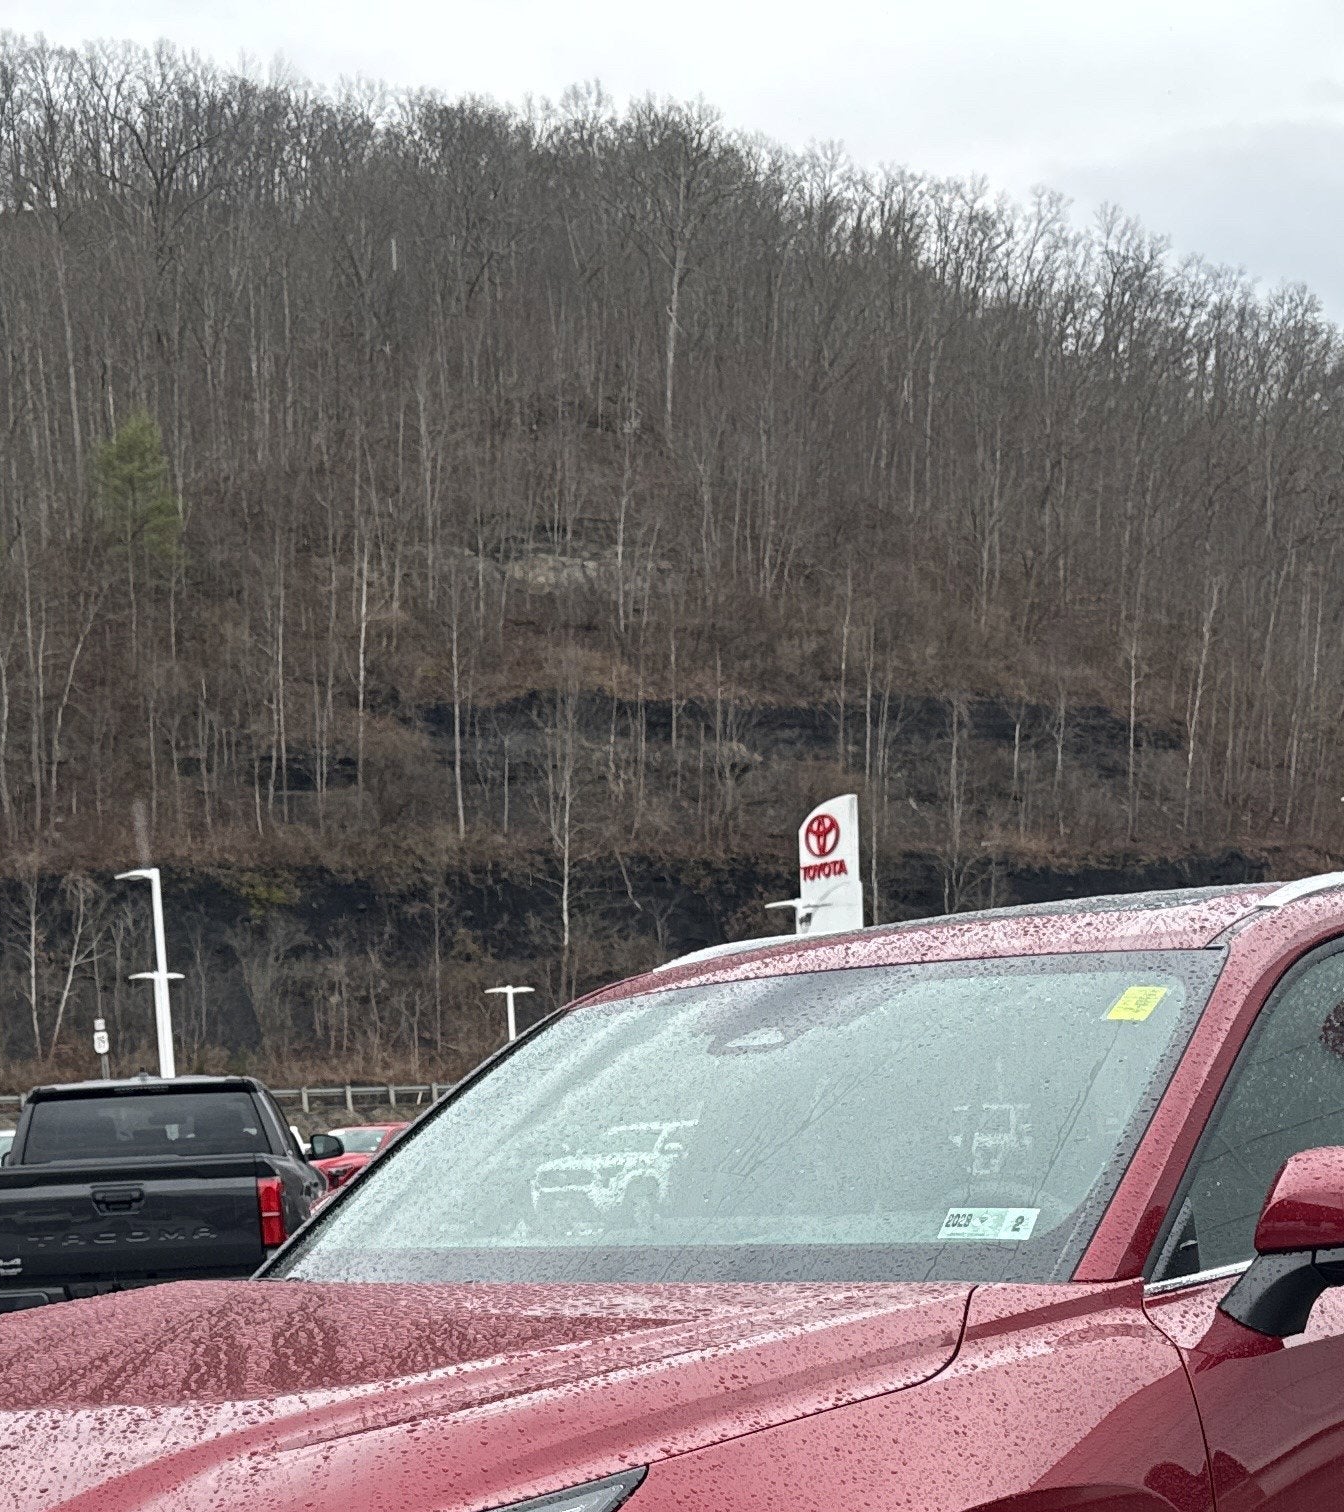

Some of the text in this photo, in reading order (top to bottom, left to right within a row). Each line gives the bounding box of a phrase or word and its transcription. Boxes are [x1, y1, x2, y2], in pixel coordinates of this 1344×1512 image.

[801, 859, 848, 882] TOYOTA
[1011, 1215, 1025, 1232] 2
[27, 1226, 218, 1249] TACOMA
